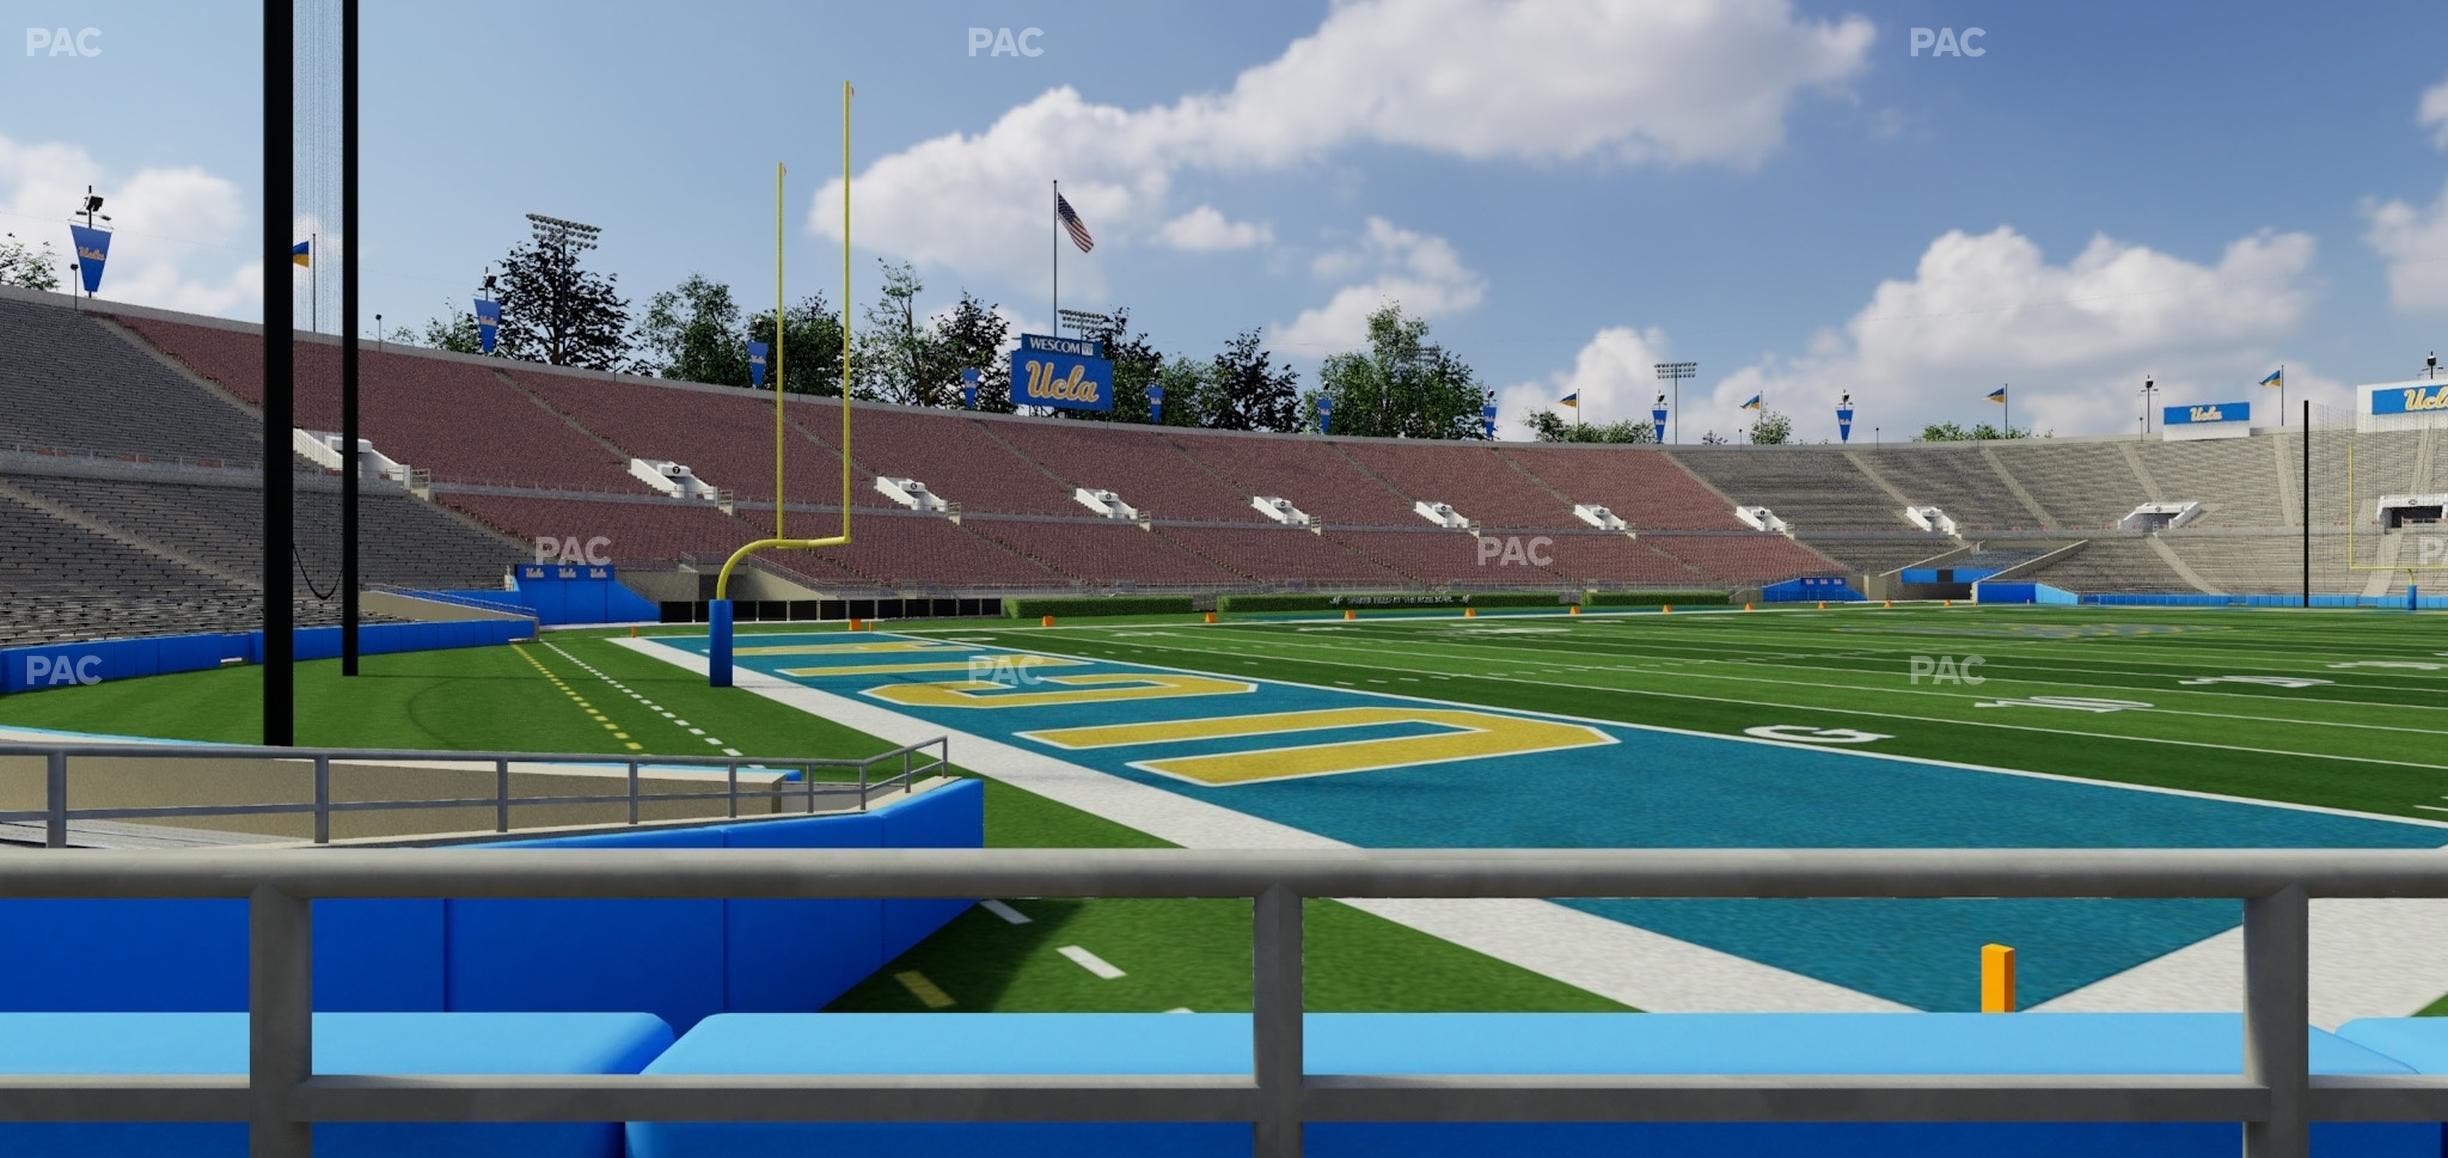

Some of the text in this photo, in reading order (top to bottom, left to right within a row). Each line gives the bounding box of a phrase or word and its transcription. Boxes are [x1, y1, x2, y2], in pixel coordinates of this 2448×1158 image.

[1029, 337, 1080, 354] WESCOM
[1025, 360, 1099, 402] Ucla
[1744, 725, 1896, 743] G
